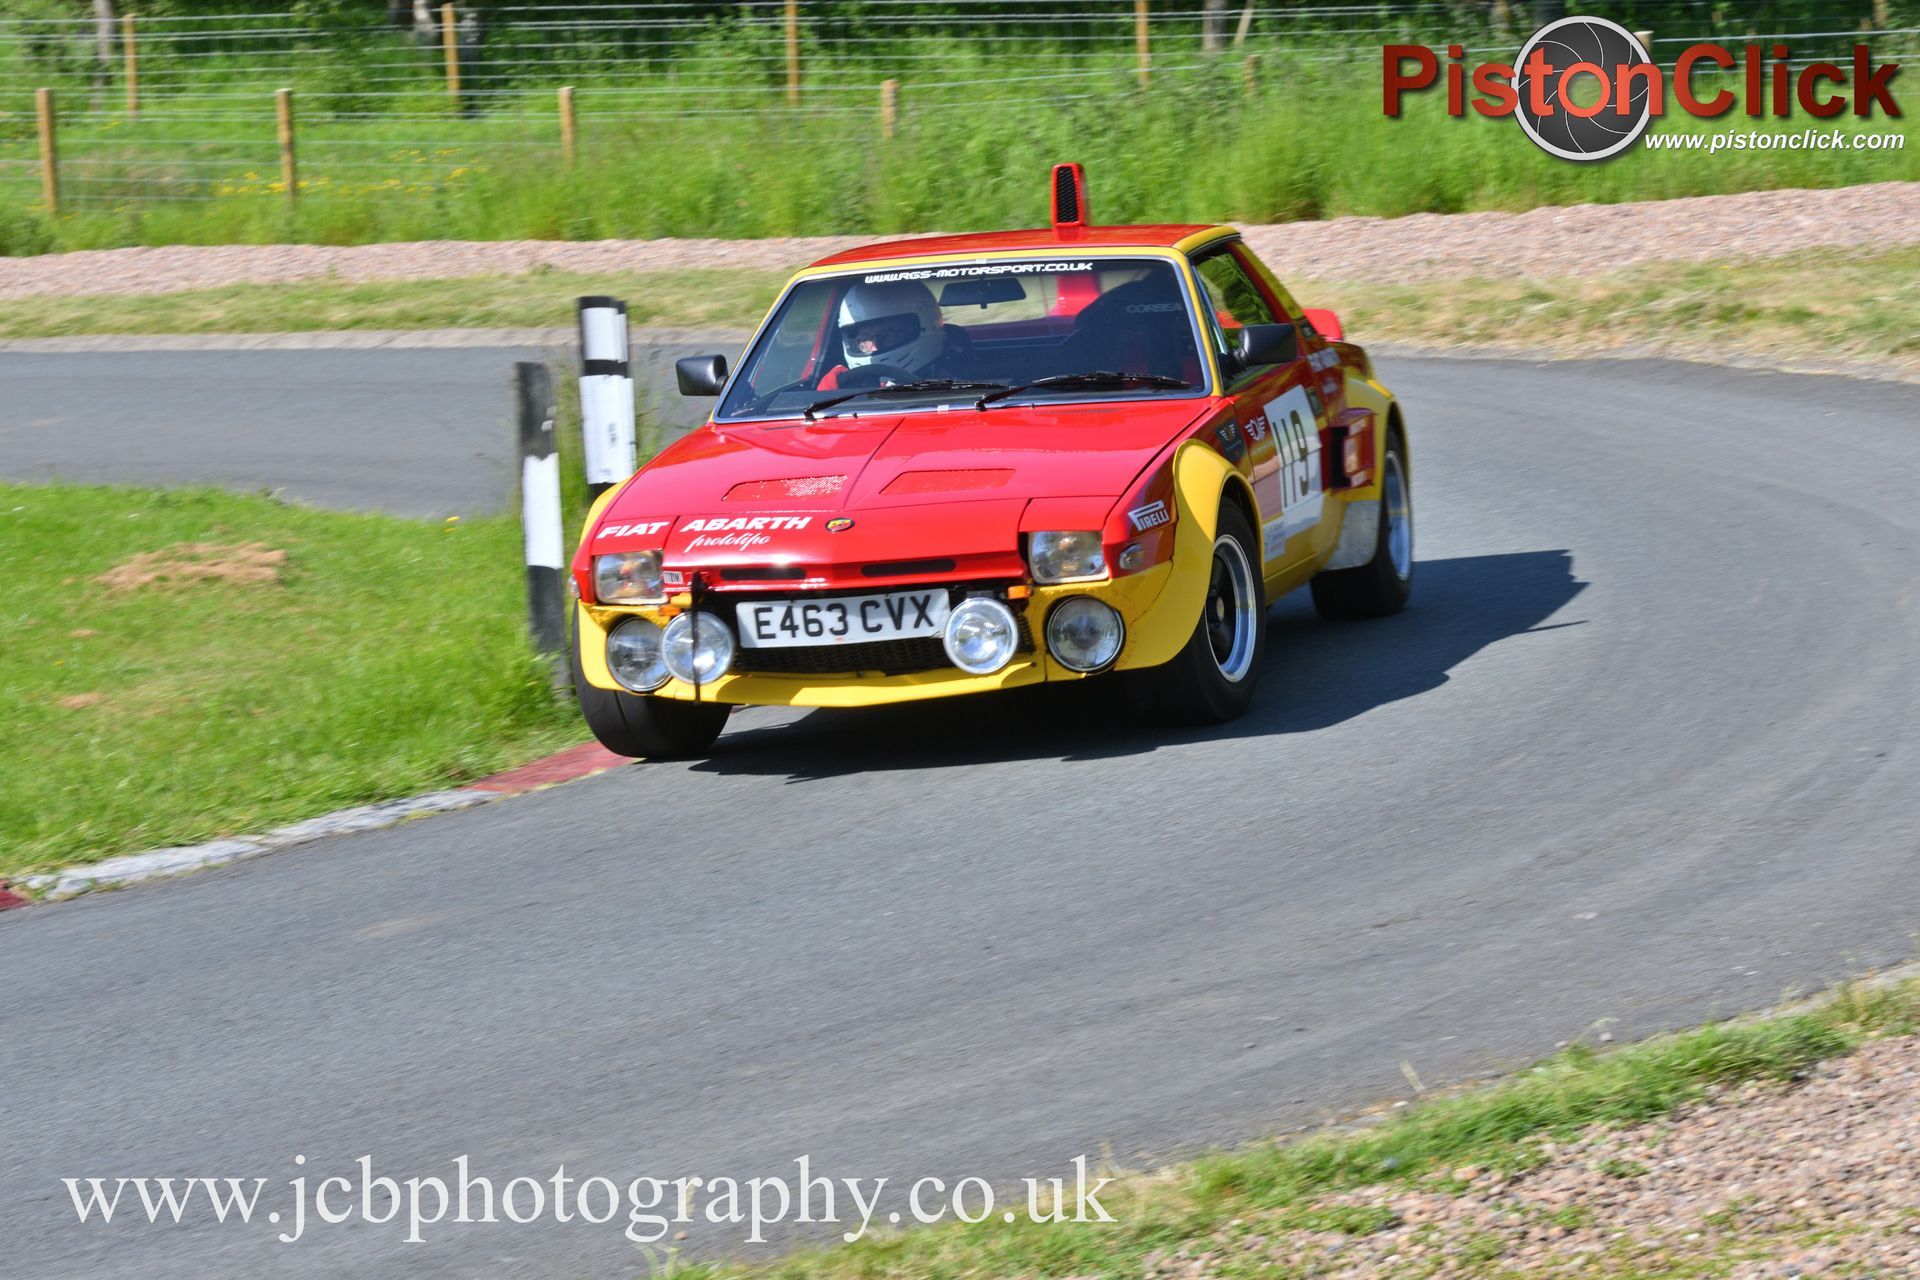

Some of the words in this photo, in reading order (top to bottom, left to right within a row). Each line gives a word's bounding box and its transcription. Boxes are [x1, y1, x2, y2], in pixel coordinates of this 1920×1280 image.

[596, 521, 670, 539] FIAT
[680, 516, 813, 533] ABARTH
[1127, 499, 1169, 532] PIRELLI
[754, 602, 849, 640] E463
[859, 594, 934, 633] CVX
